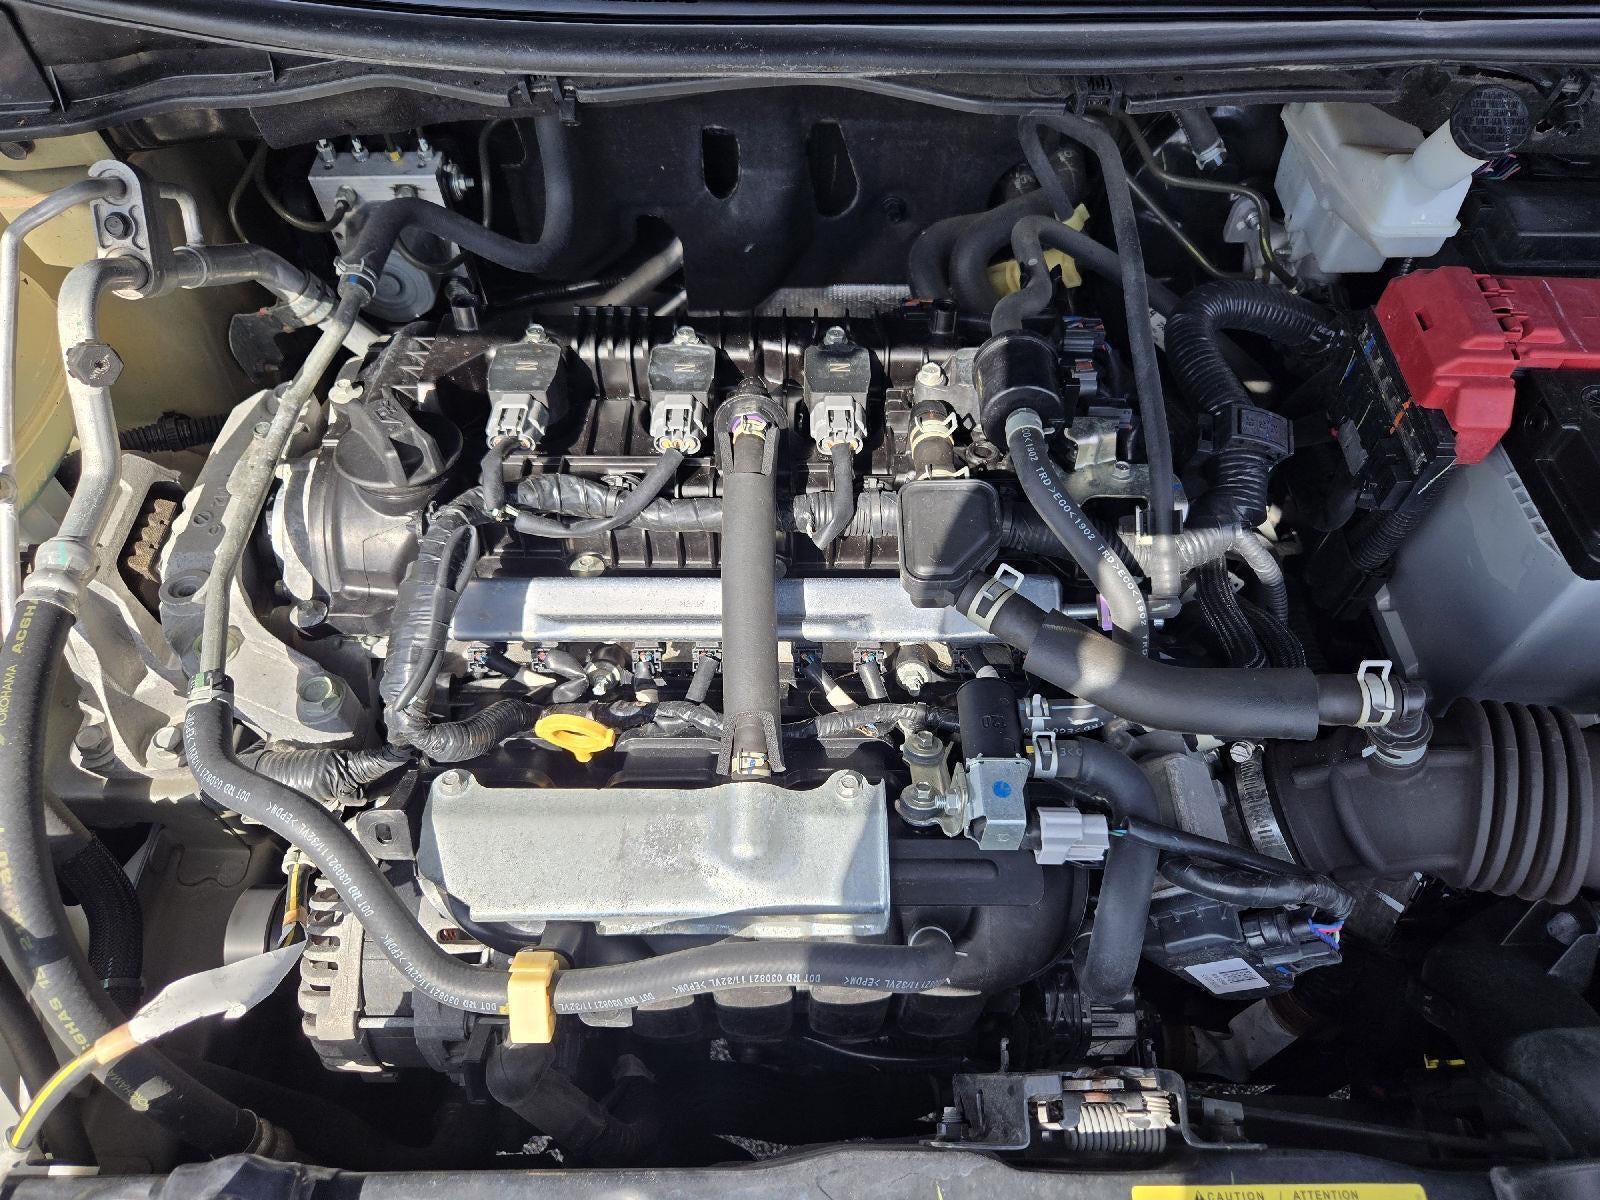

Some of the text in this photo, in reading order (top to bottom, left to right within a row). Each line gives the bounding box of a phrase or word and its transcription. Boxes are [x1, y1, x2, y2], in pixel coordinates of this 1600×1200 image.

[749, 973, 783, 984] 030821
[1207, 1191, 1265, 1200] CAUTION
[1293, 1190, 1359, 1200] ATTENTION
